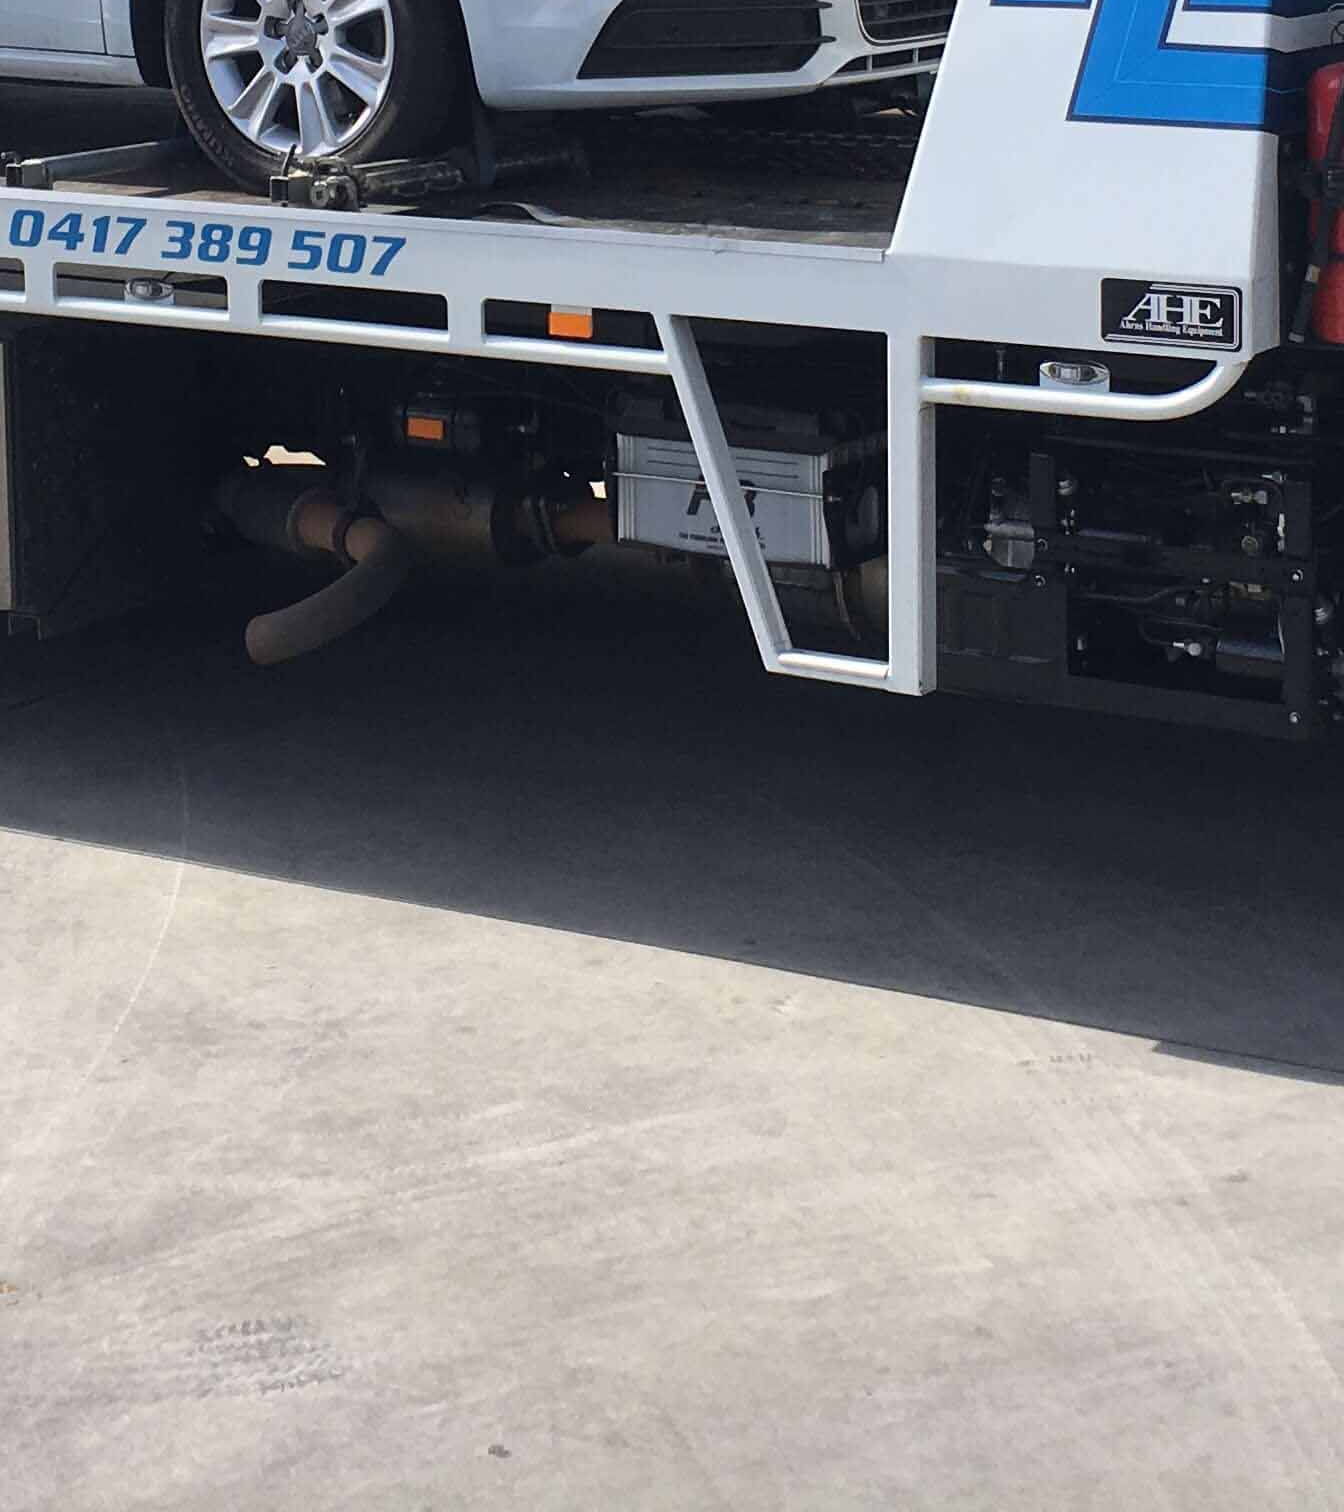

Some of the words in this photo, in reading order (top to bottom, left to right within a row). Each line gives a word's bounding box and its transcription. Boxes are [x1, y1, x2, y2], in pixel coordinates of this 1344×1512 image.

[9, 209, 148, 256] 0417
[160, 221, 273, 267] 389
[287, 230, 407, 277] 507
[1122, 292, 1224, 328] AHE
